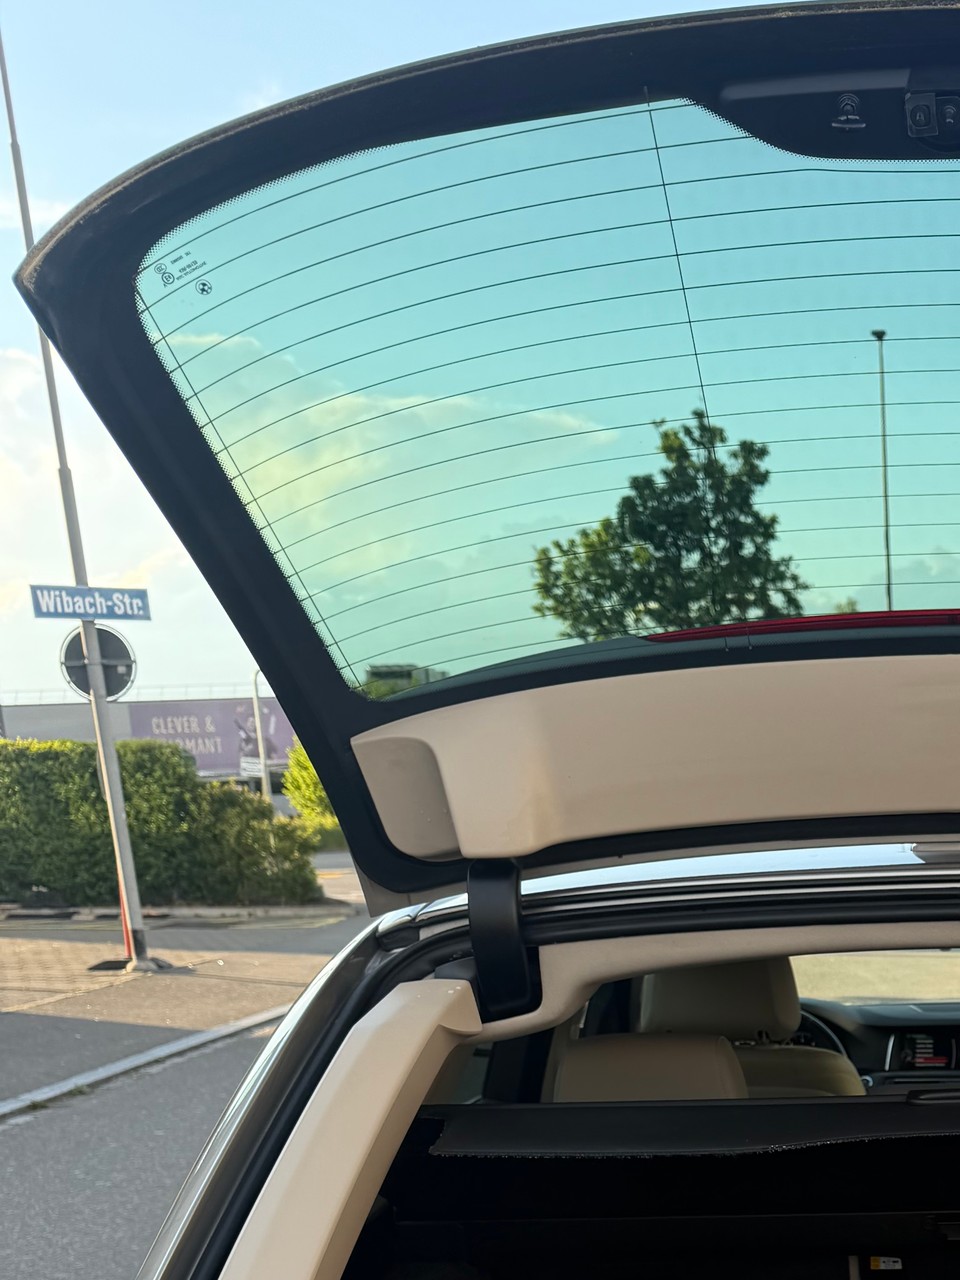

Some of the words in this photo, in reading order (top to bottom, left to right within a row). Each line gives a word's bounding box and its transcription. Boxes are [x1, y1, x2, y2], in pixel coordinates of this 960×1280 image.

[35, 589, 144, 616] Wibach-Str.
[152, 715, 200, 735] CLEVER
[204, 714, 217, 733] &
